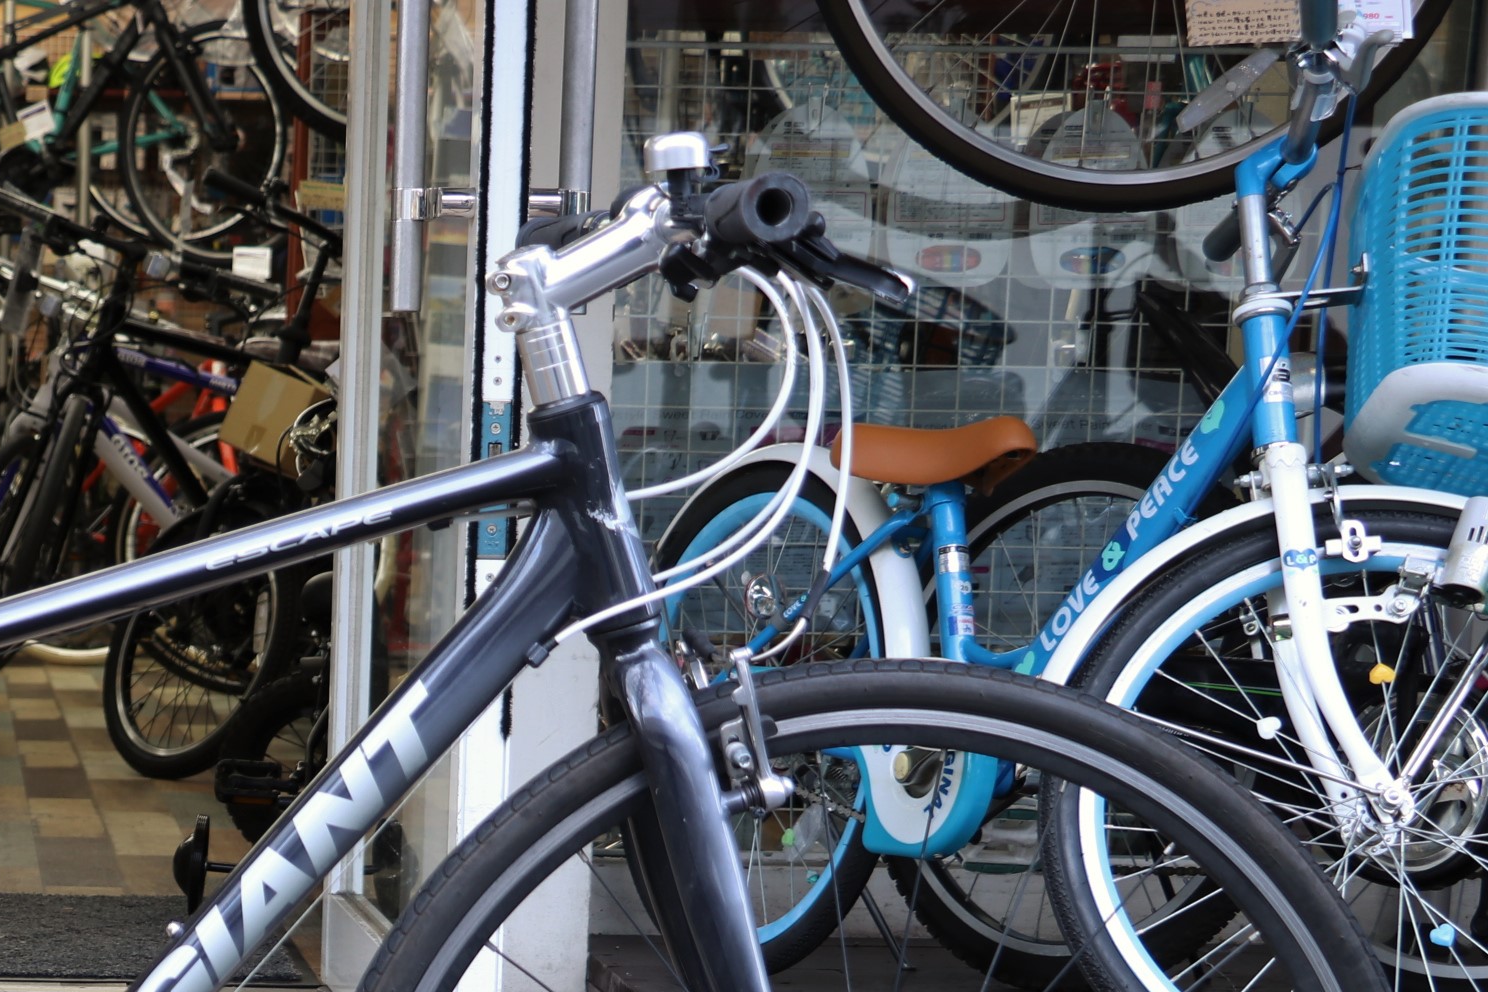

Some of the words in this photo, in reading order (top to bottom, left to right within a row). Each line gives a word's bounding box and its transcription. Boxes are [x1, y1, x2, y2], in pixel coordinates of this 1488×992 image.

[205, 510, 393, 571] ESCAPE
[1040, 569, 1099, 652] LOVE
[1101, 541, 1126, 571] &
[1126, 440, 1200, 541] PEACE
